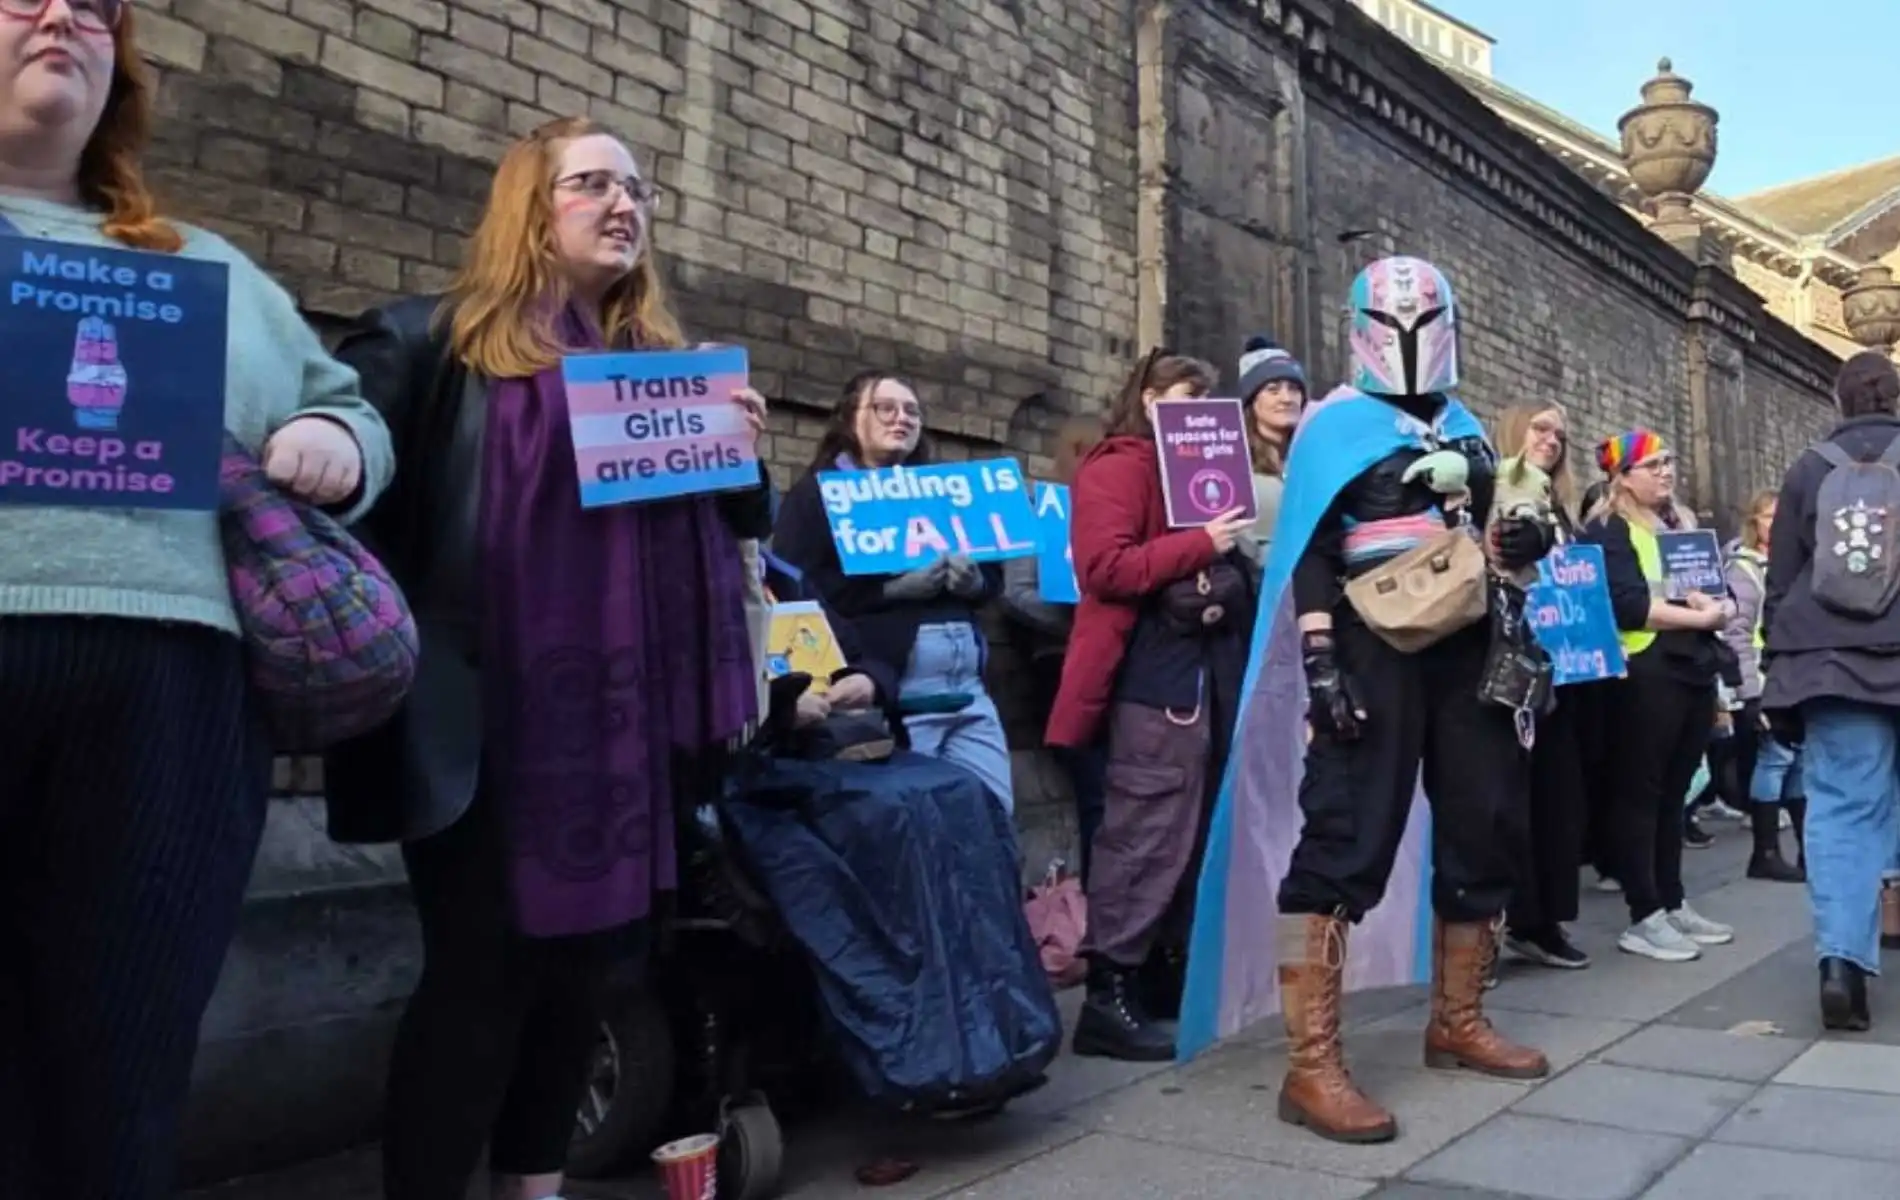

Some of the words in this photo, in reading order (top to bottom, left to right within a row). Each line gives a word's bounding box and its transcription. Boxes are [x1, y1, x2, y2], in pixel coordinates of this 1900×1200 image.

[22, 251, 138, 287] Make
[146, 269, 173, 291] a
[11, 281, 183, 323] Promise
[606, 373, 708, 402] Trans
[624, 408, 706, 439] Girls
[1219, 427, 1239, 441] for
[17, 427, 125, 464] Keep
[135, 440, 162, 461] a
[596, 457, 656, 483] are
[664, 442, 743, 475] Girls
[0, 461, 174, 493] Promise
[820, 464, 973, 514] guiding
[833, 518, 898, 555] for
[905, 512, 1035, 557] ALL
